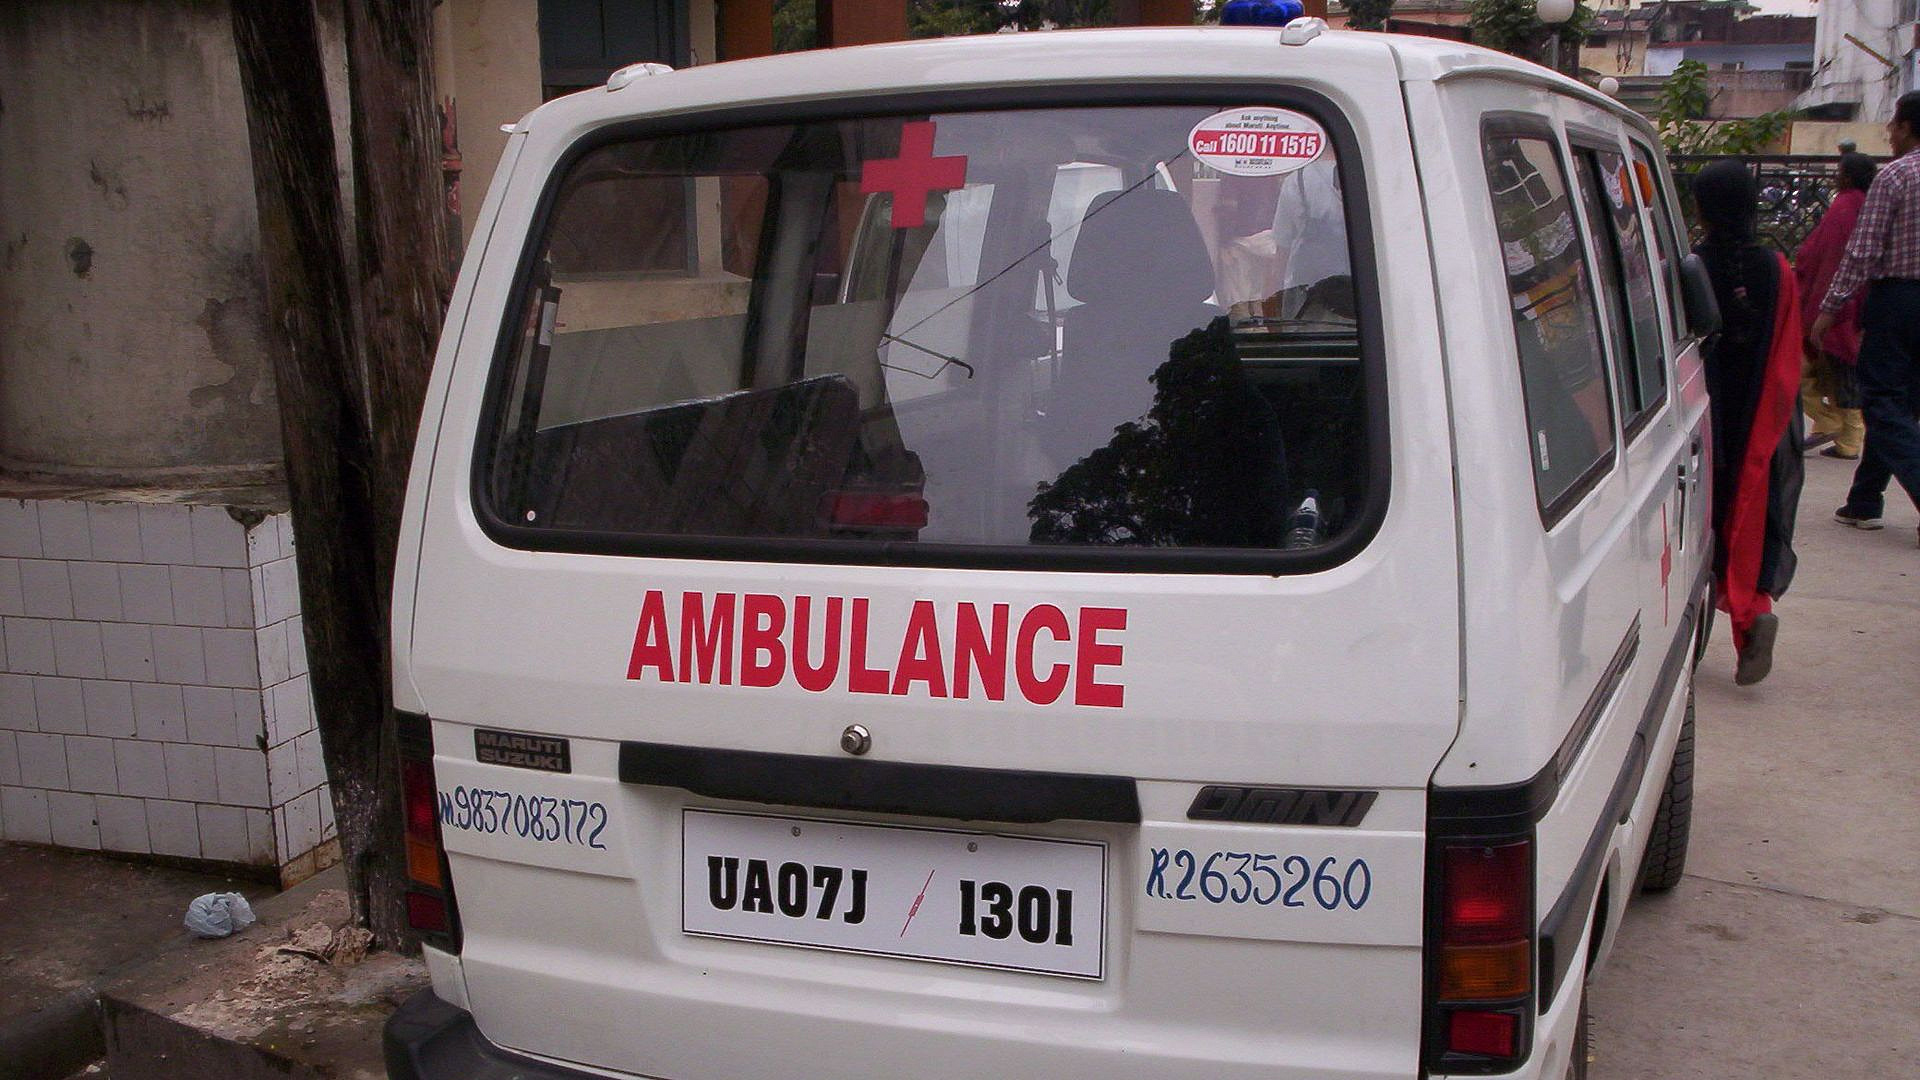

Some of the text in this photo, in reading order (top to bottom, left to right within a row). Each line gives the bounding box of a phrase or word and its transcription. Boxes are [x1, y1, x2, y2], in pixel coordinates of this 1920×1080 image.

[1196, 133, 1318, 156] Call 1600 11 1515
[626, 590, 1128, 708] AMBULANCE
[478, 732, 562, 754] MARUTI
[480, 748, 563, 770] SUZUKI
[1188, 787, 1378, 827] OMNI
[707, 855, 868, 925] UA07J
